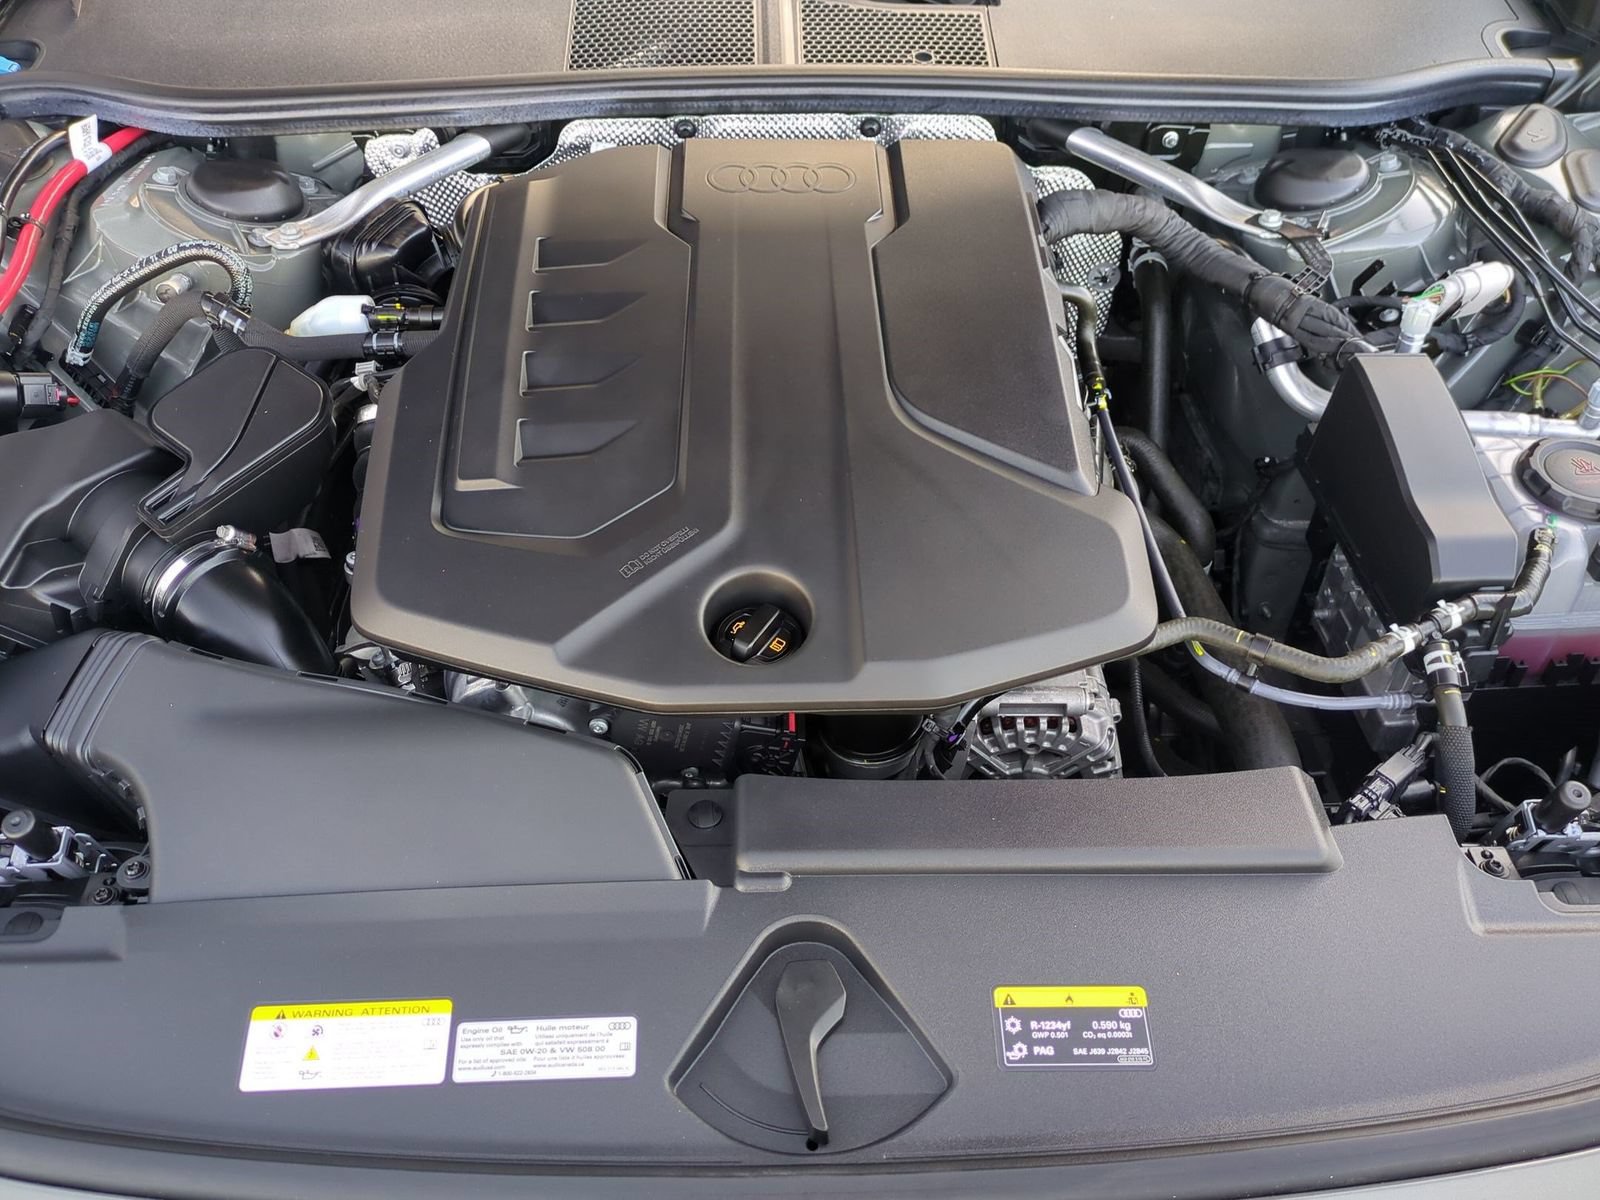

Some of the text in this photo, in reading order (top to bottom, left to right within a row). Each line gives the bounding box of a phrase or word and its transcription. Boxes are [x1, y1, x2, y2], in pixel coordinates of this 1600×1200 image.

[292, 1006, 431, 1018] WARNING ATTENTION
[1030, 1020, 1131, 1031] R-1234yf 0.590 kg
[462, 1027, 490, 1035] Engine
[1033, 1046, 1055, 1056] PAG
